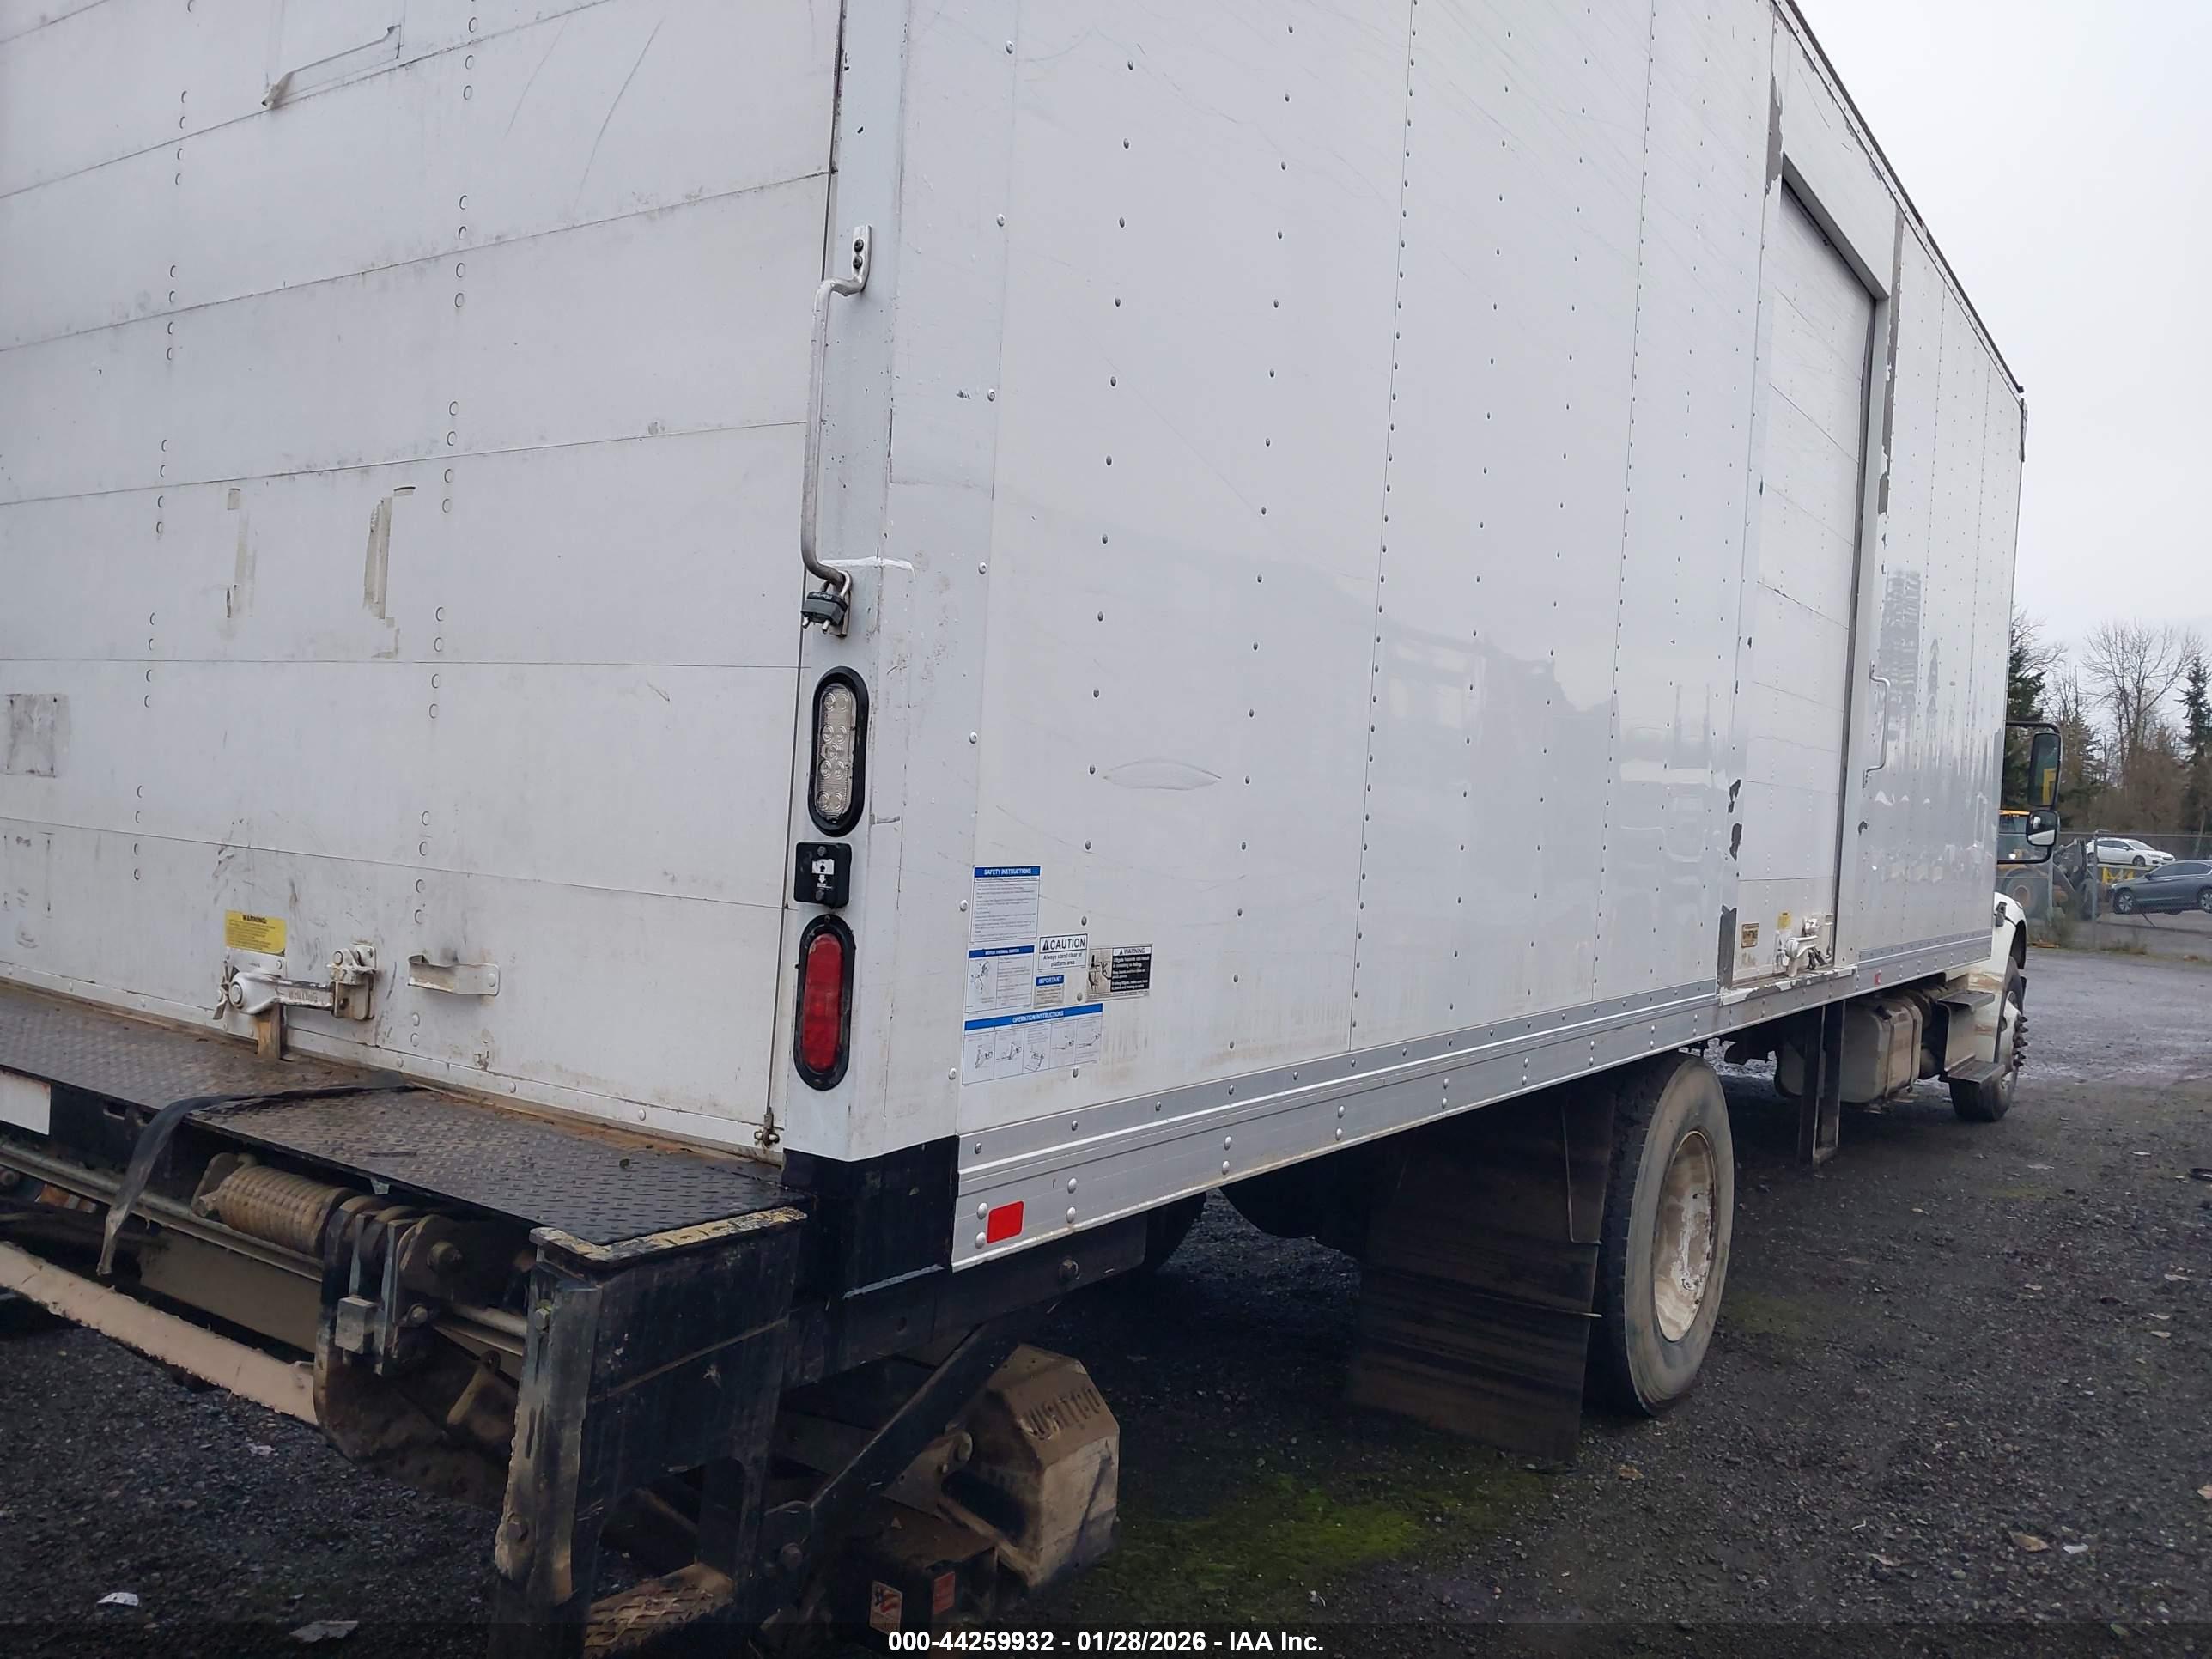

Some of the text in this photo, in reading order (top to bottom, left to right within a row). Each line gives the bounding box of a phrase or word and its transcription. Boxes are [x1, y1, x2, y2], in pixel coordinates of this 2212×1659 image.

[1050, 938, 1085, 950] CAUTION
[1038, 975, 1062, 984] IMPORTANT
[1036, 1011, 1064, 1019] INSTRUCTIONS
